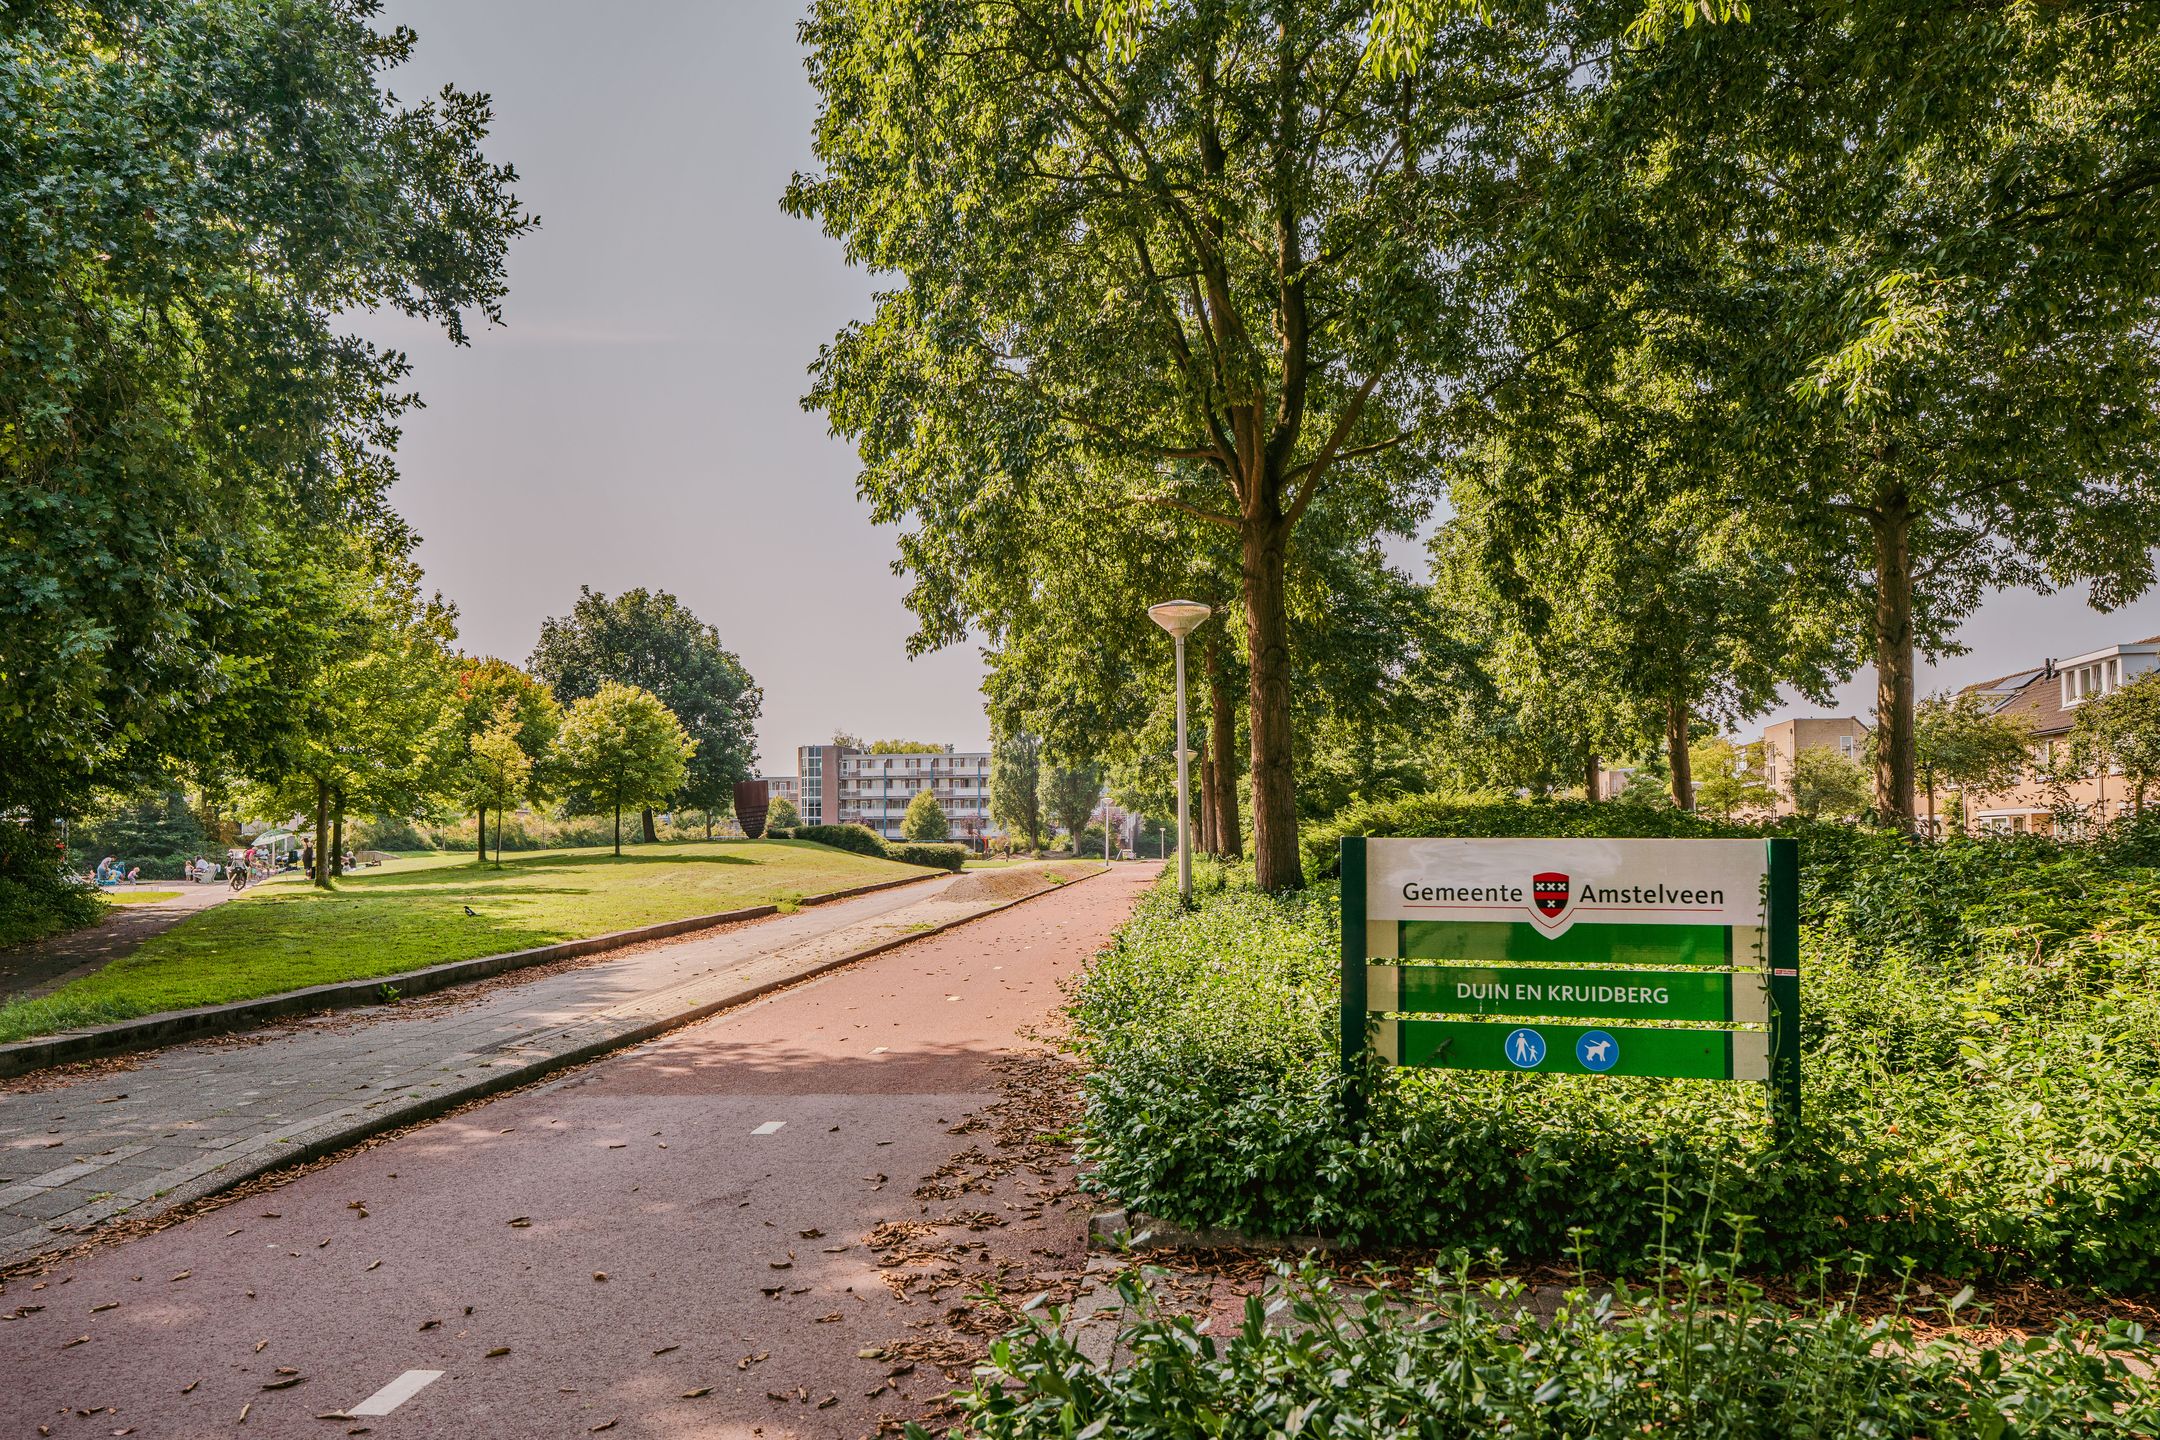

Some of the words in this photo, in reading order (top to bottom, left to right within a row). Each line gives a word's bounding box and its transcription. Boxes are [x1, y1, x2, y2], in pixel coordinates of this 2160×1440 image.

[1402, 882, 1523, 903] Gemeente
[1579, 884, 1724, 905] Amstelveen
[1457, 982, 1510, 1001] DUIN
[1515, 984, 1542, 1001] EN
[1548, 984, 1669, 1005] KRUIDBERG
